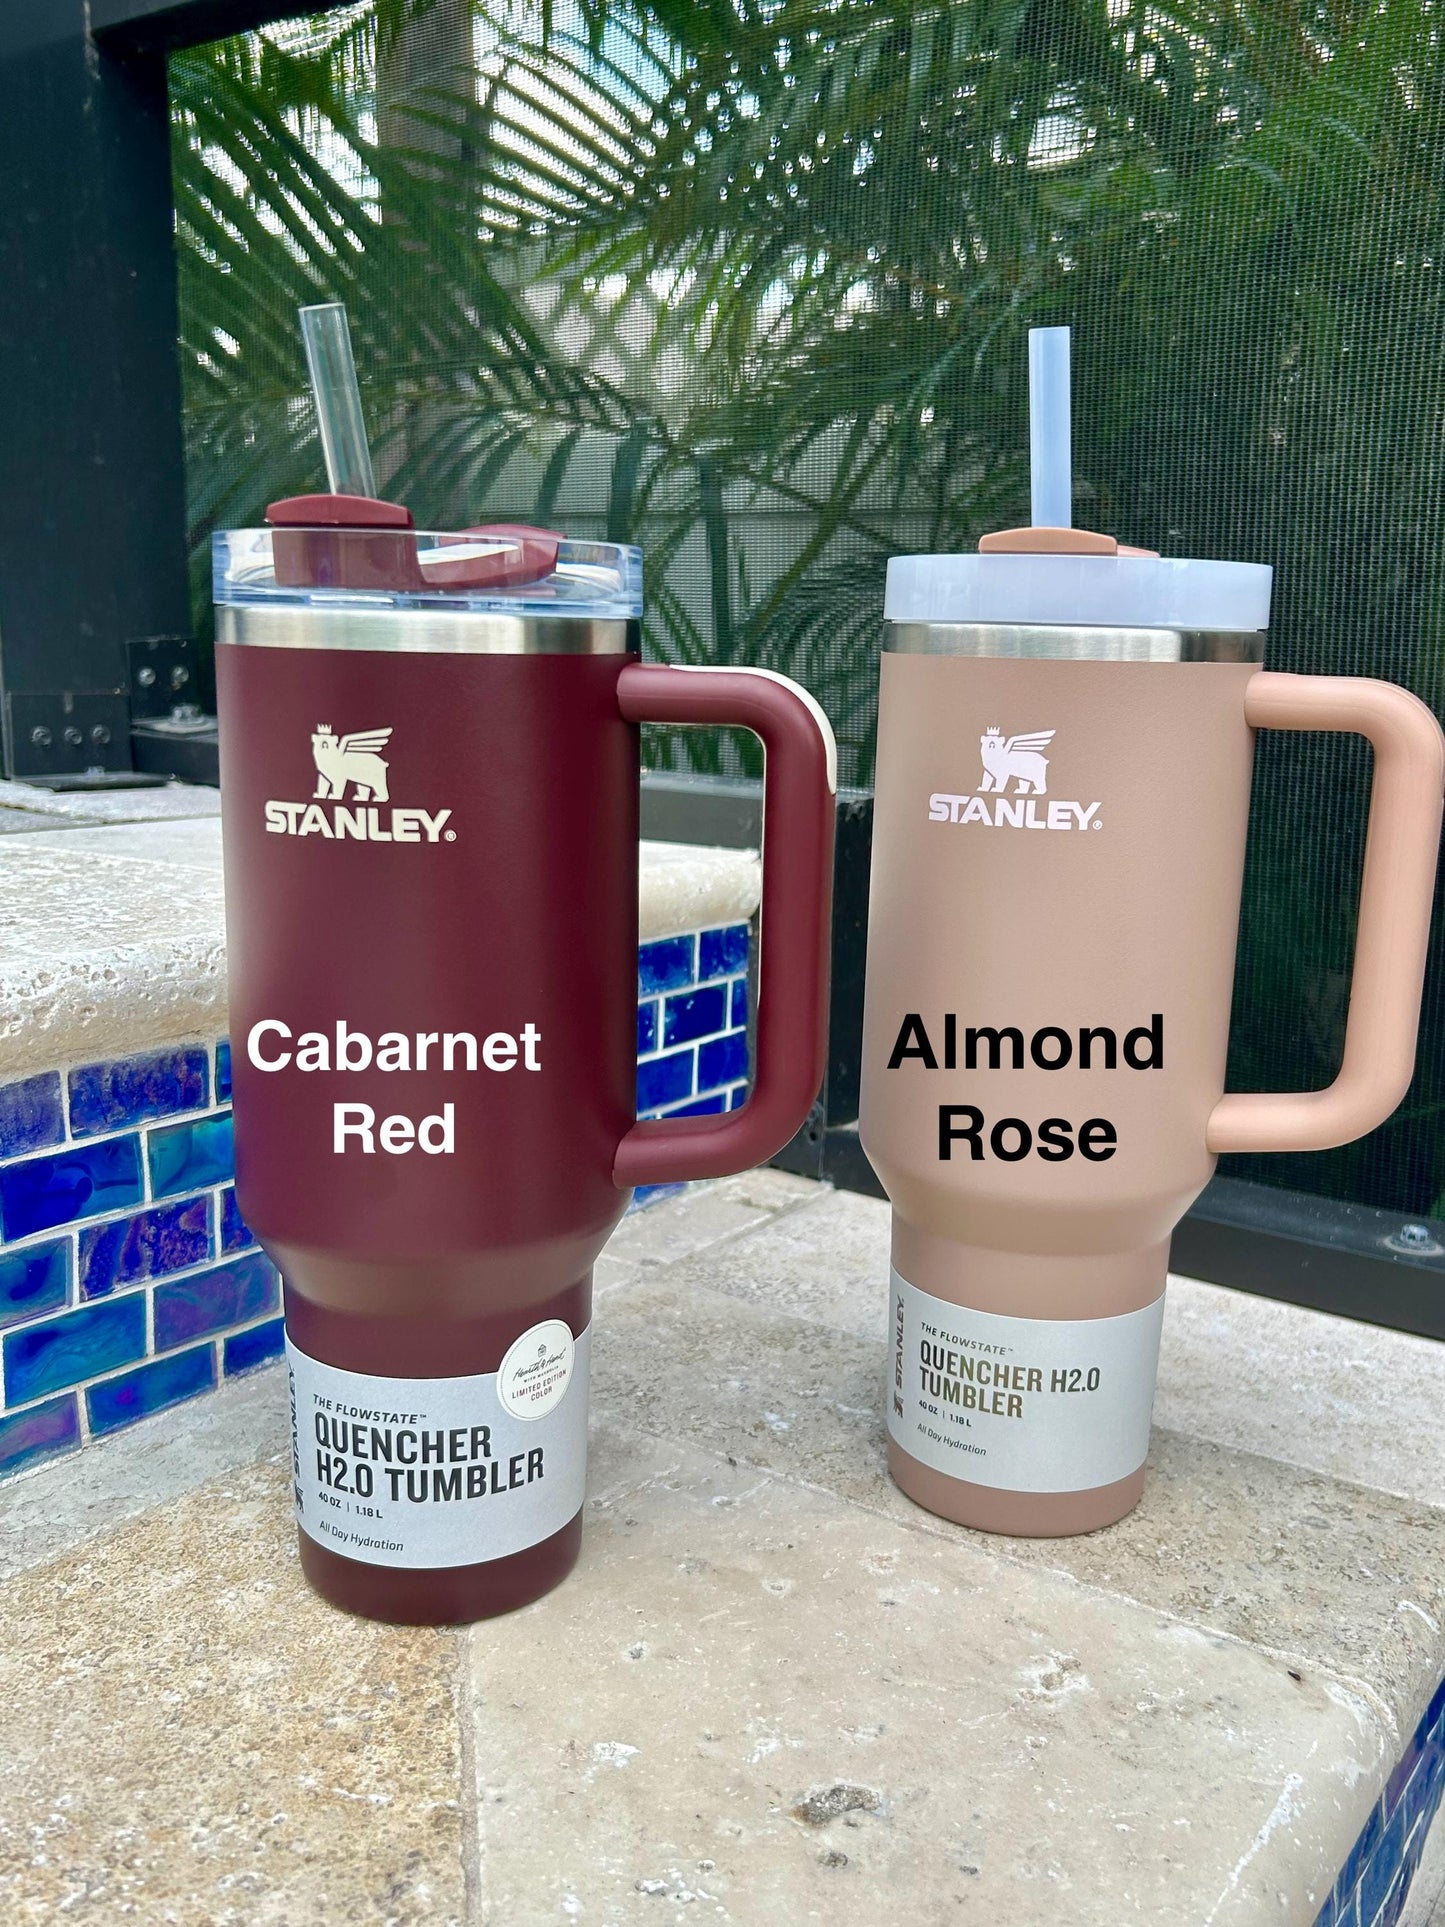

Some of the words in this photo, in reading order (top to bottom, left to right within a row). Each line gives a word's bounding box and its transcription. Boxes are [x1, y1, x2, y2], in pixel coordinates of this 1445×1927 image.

[921, 1321, 938, 1337] THE
[920, 1339, 1043, 1393] QUENCHER
[512, 1382, 541, 1399] LIMITED
[543, 1369, 566, 1386] EDITION
[531, 1386, 553, 1401] COLOR
[919, 1365, 1023, 1418] TUMBLER
[313, 1393, 333, 1410] THE
[918, 1400, 928, 1410] 40
[928, 1404, 939, 1416] OZ
[949, 1413, 965, 1426] 1.18
[965, 1418, 973, 1428] L
[314, 1411, 492, 1465] QUENCHER
[917, 1423, 928, 1435] All
[927, 1428, 942, 1443] Day
[942, 1435, 987, 1457] Hydration
[384, 1447, 546, 1504] TUMBLER
[318, 1491, 329, 1503] 40
[329, 1498, 342, 1510] OZ
[355, 1505, 375, 1518] 1.18
[376, 1509, 383, 1519] L
[319, 1520, 331, 1533] All
[331, 1526, 350, 1543] Day
[350, 1533, 405, 1553] Hydration
